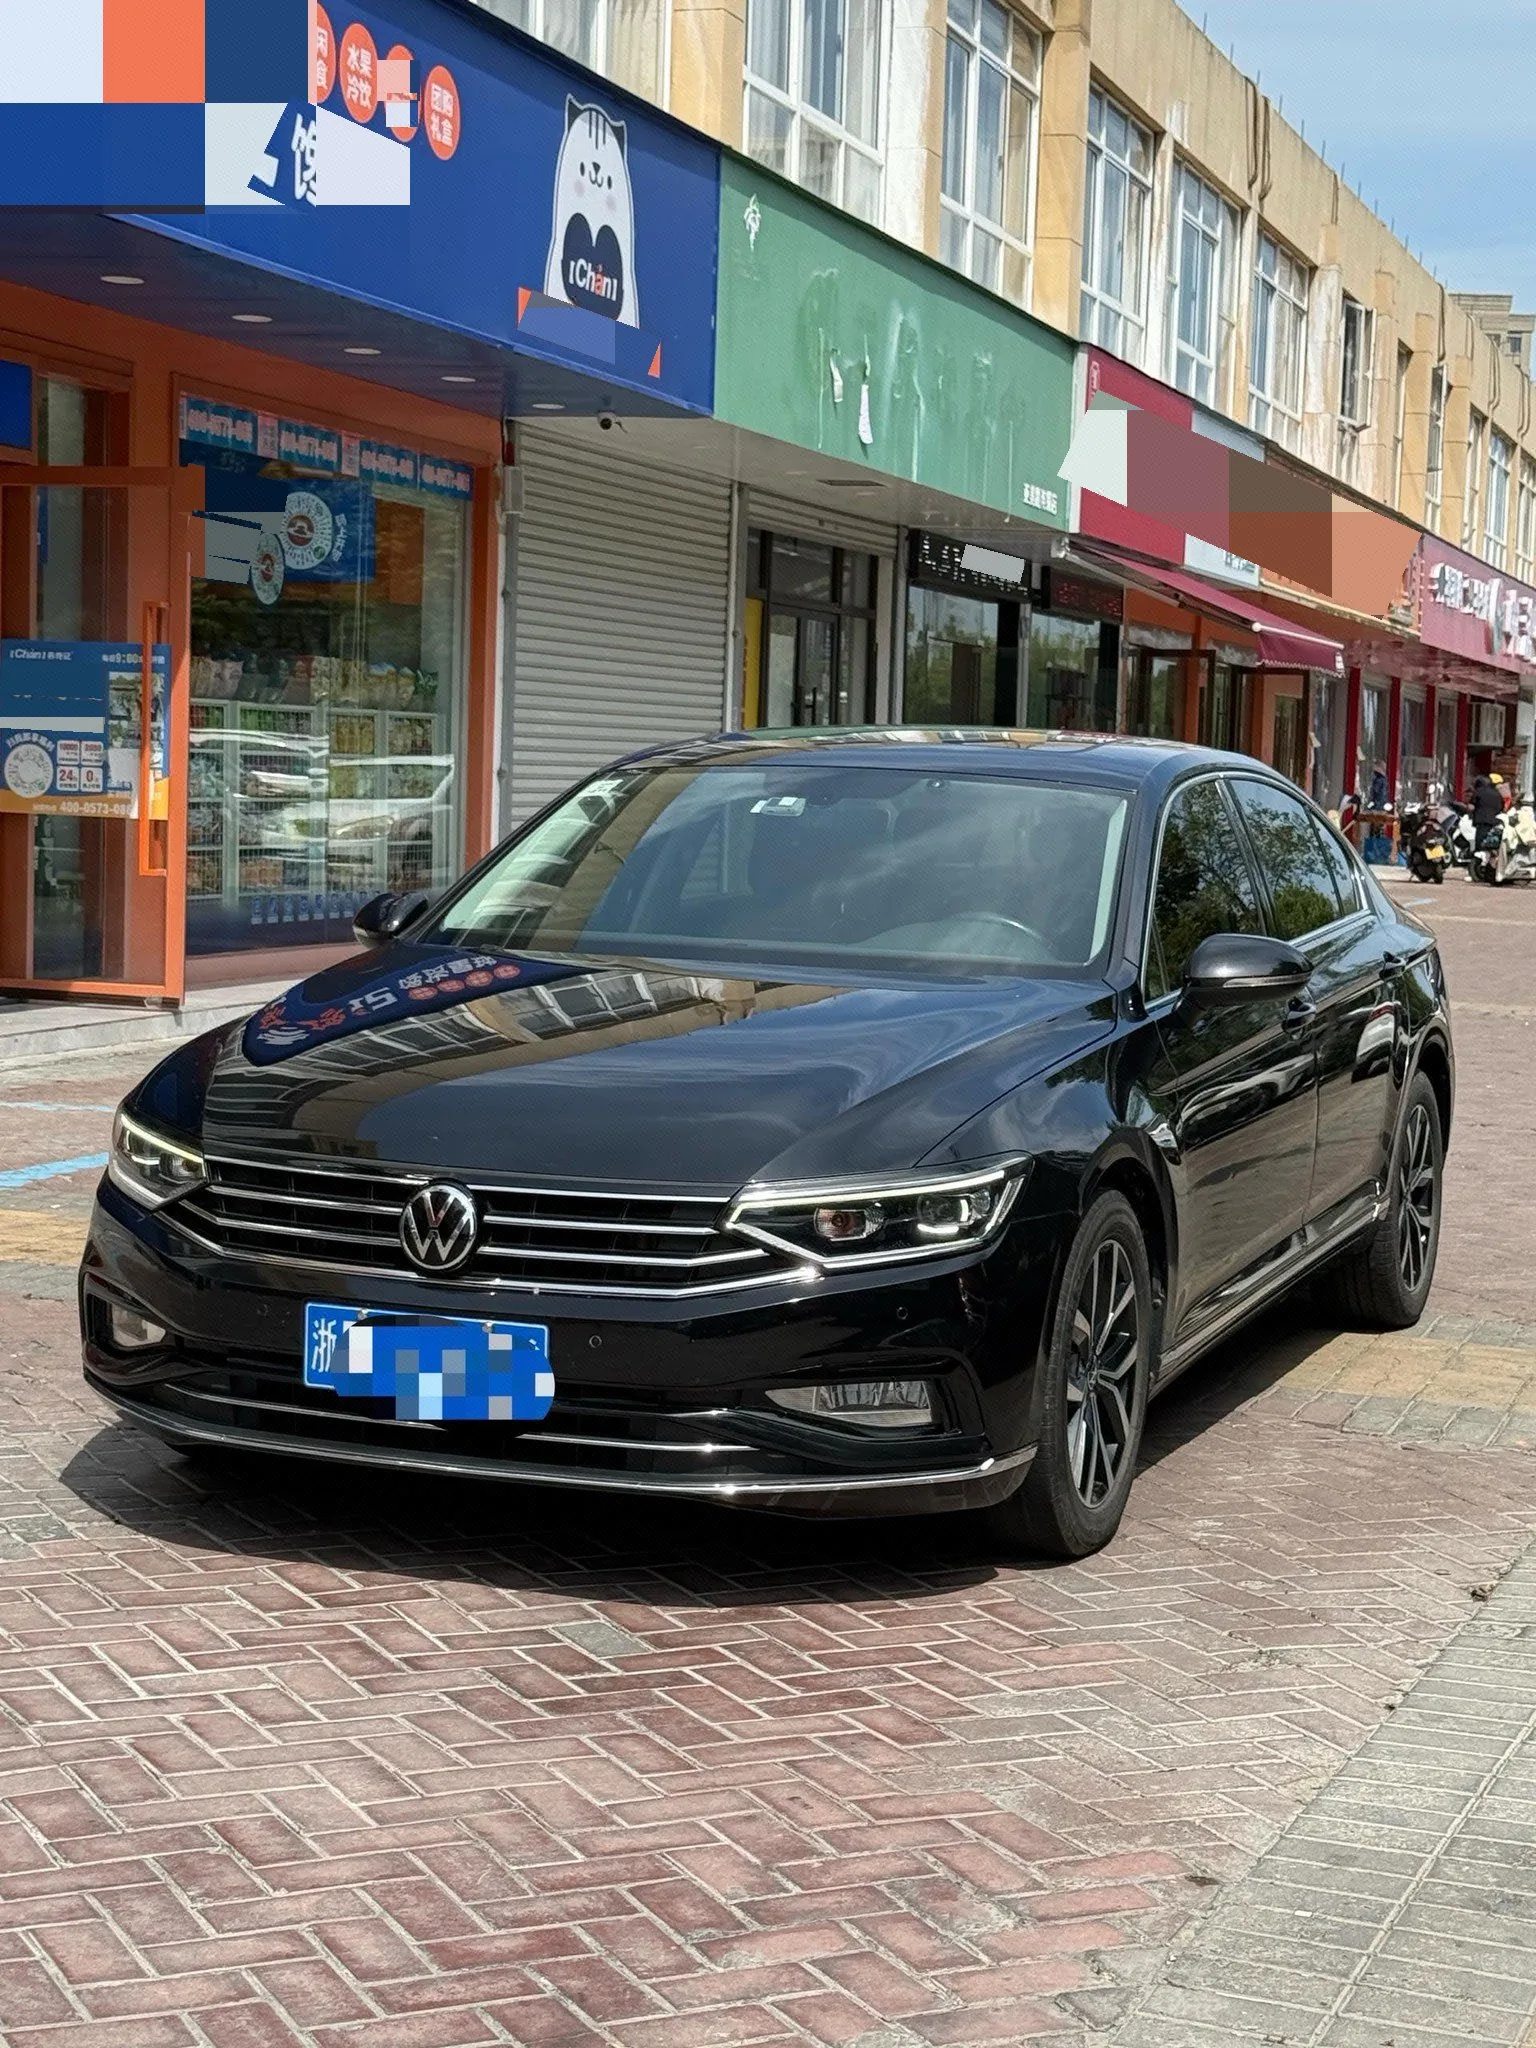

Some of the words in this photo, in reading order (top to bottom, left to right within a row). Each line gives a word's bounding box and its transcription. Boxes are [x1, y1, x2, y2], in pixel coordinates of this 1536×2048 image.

[346, 43, 373, 79] 水果
[346, 73, 372, 110] 冷饮
[430, 83, 454, 118] 团购
[430, 112, 454, 148] 礼盒
